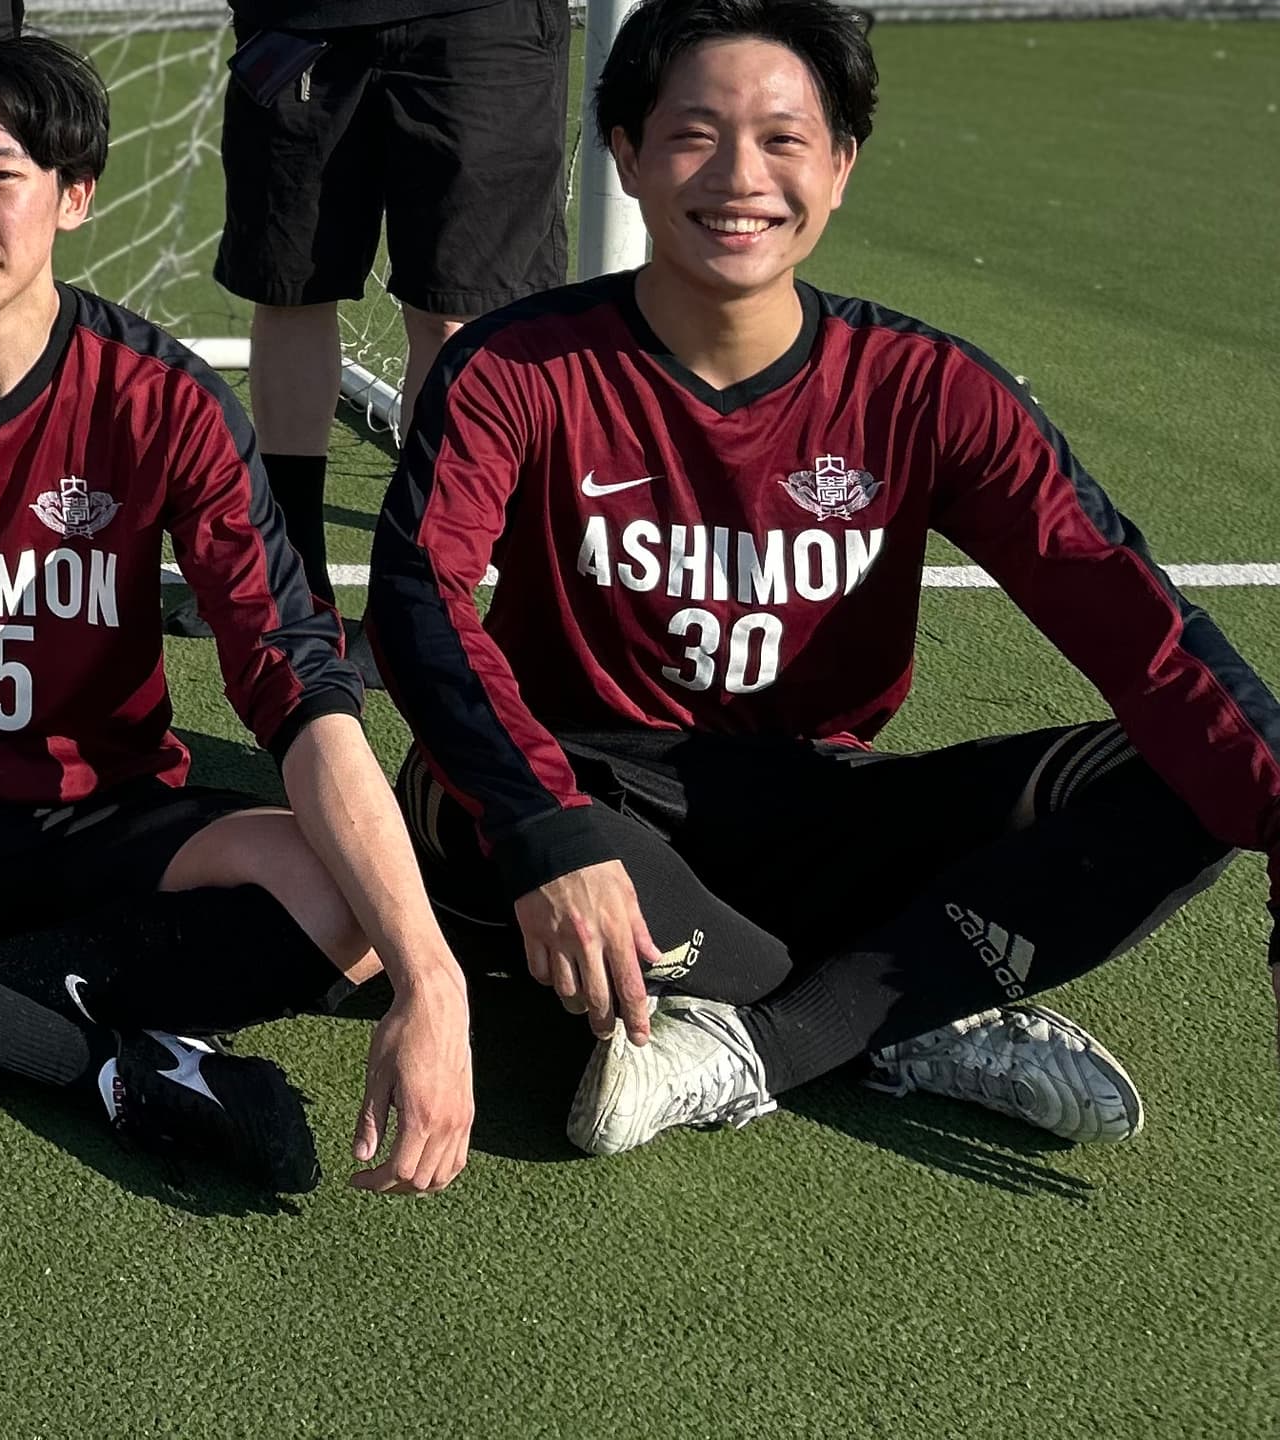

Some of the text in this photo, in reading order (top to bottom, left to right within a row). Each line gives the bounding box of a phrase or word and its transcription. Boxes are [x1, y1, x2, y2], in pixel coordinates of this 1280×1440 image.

[576, 514, 887, 607] ASHIMON
[661, 607, 784, 695] 30
[944, 901, 1023, 999] adidas
